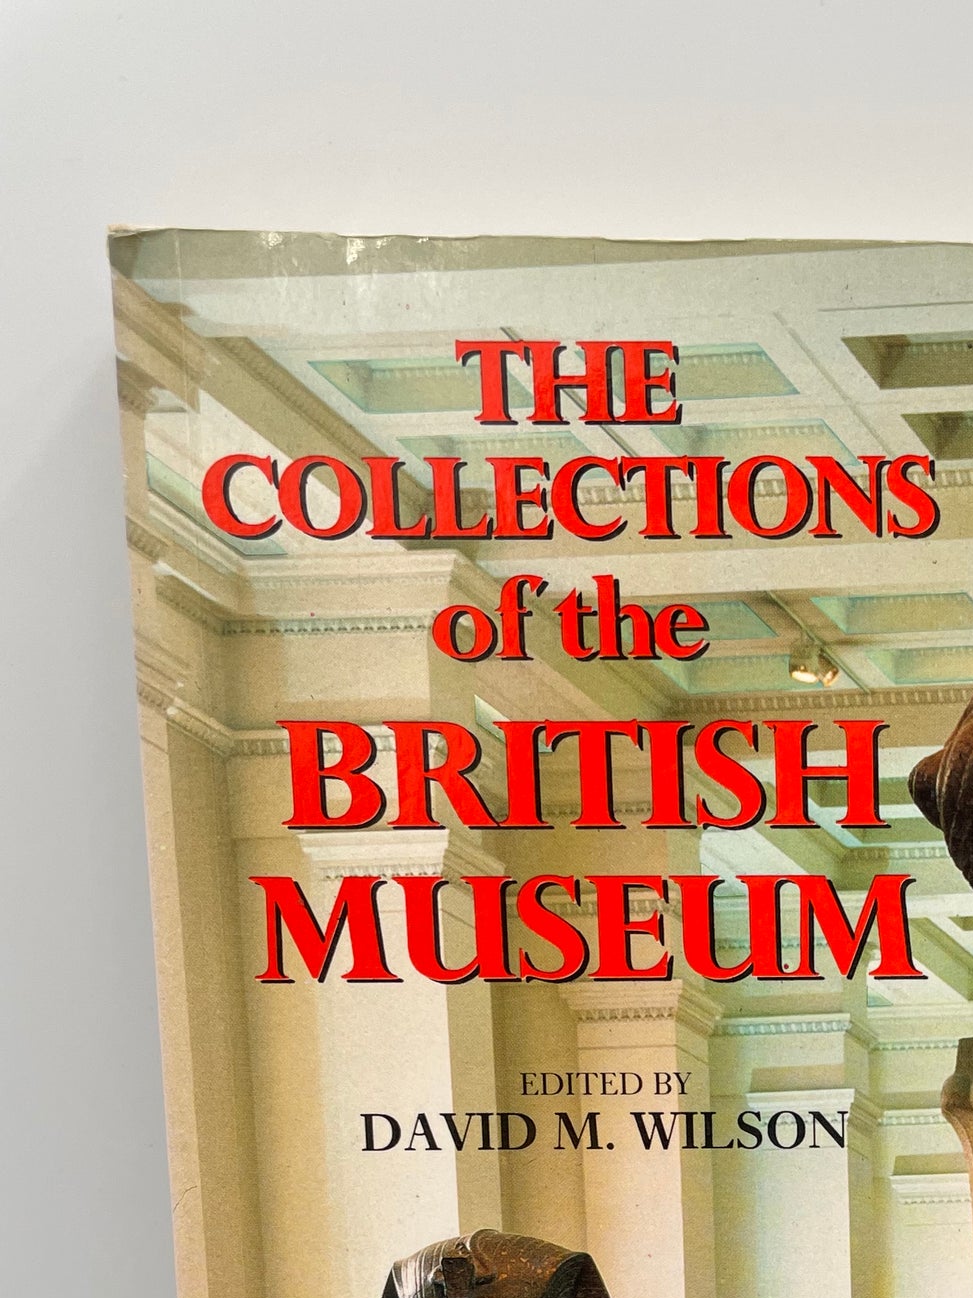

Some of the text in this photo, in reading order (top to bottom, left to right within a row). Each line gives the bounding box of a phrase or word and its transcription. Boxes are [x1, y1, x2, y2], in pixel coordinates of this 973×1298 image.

[455, 340, 683, 426] THE
[201, 453, 941, 540] COLLECTIONS
[431, 574, 711, 662] of the
[277, 719, 892, 831] BRITISH
[250, 873, 928, 983] MUSEUM
[520, 1071, 692, 1097] EDITED BY
[361, 1109, 849, 1153] DAVID M. WILSON
